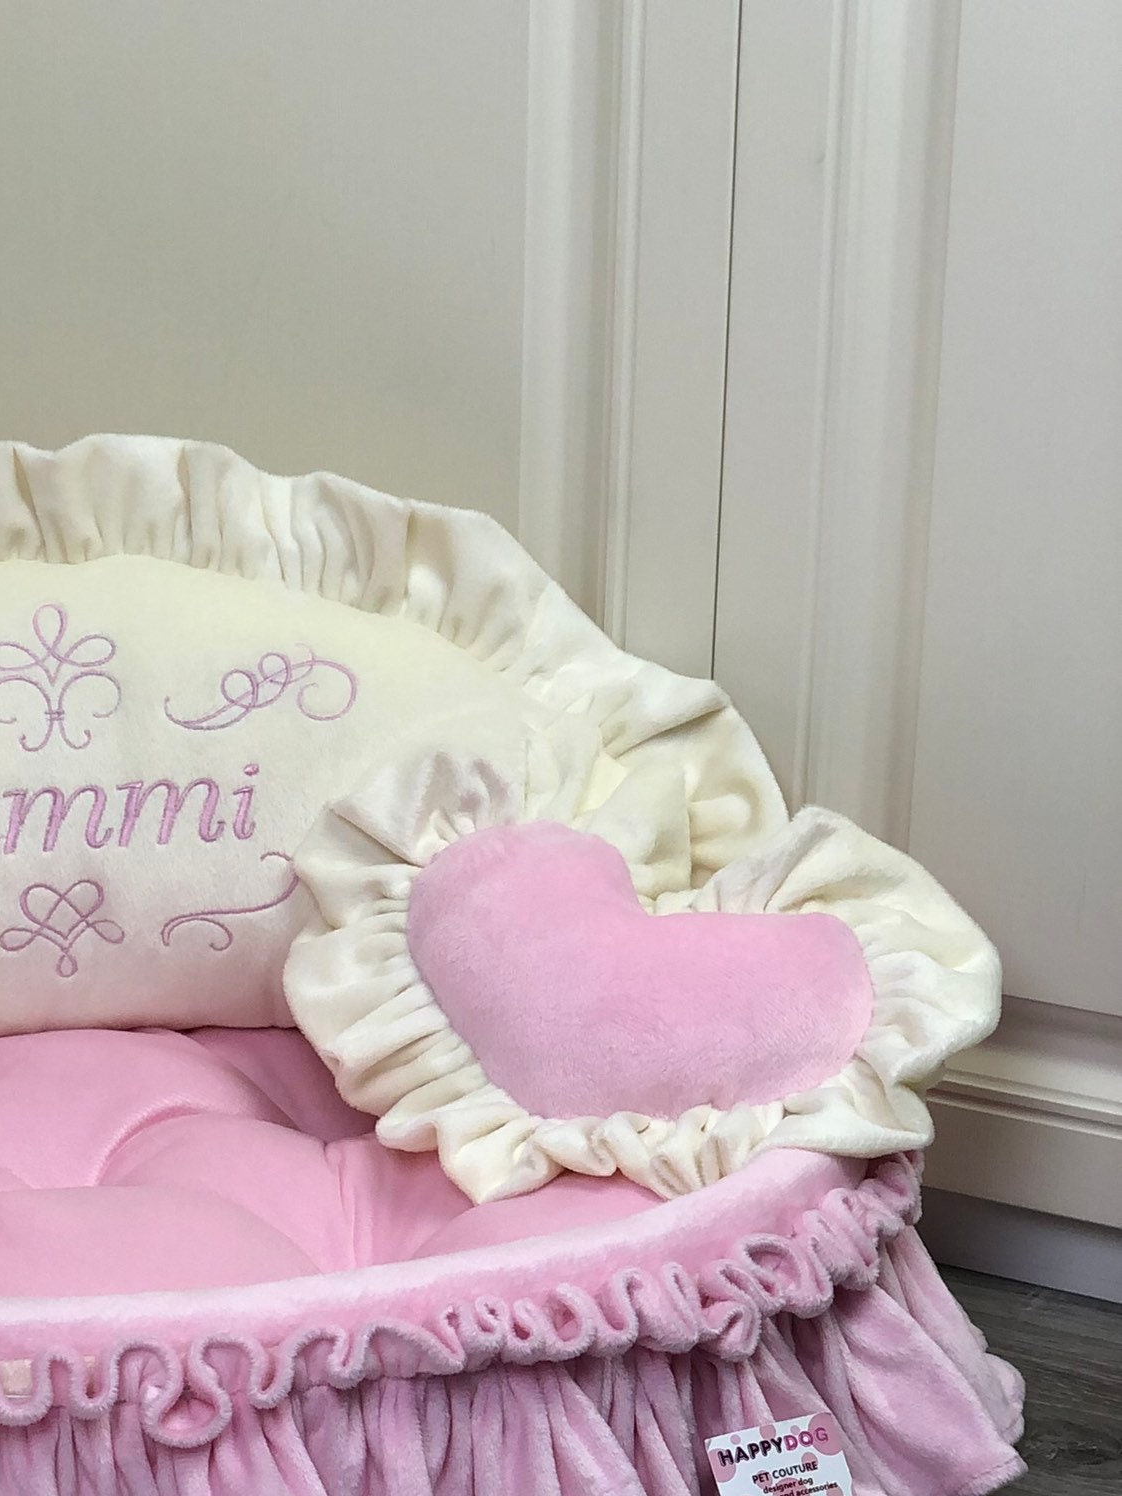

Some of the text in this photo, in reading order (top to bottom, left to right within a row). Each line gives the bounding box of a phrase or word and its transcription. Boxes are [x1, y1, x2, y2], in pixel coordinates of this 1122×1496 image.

[718, 1427, 829, 1467] HAPPYDOG
[752, 1461, 819, 1484] PET COUTURE
[763, 1477, 814, 1495] designer dog
[796, 1481, 839, 1496] accessories
